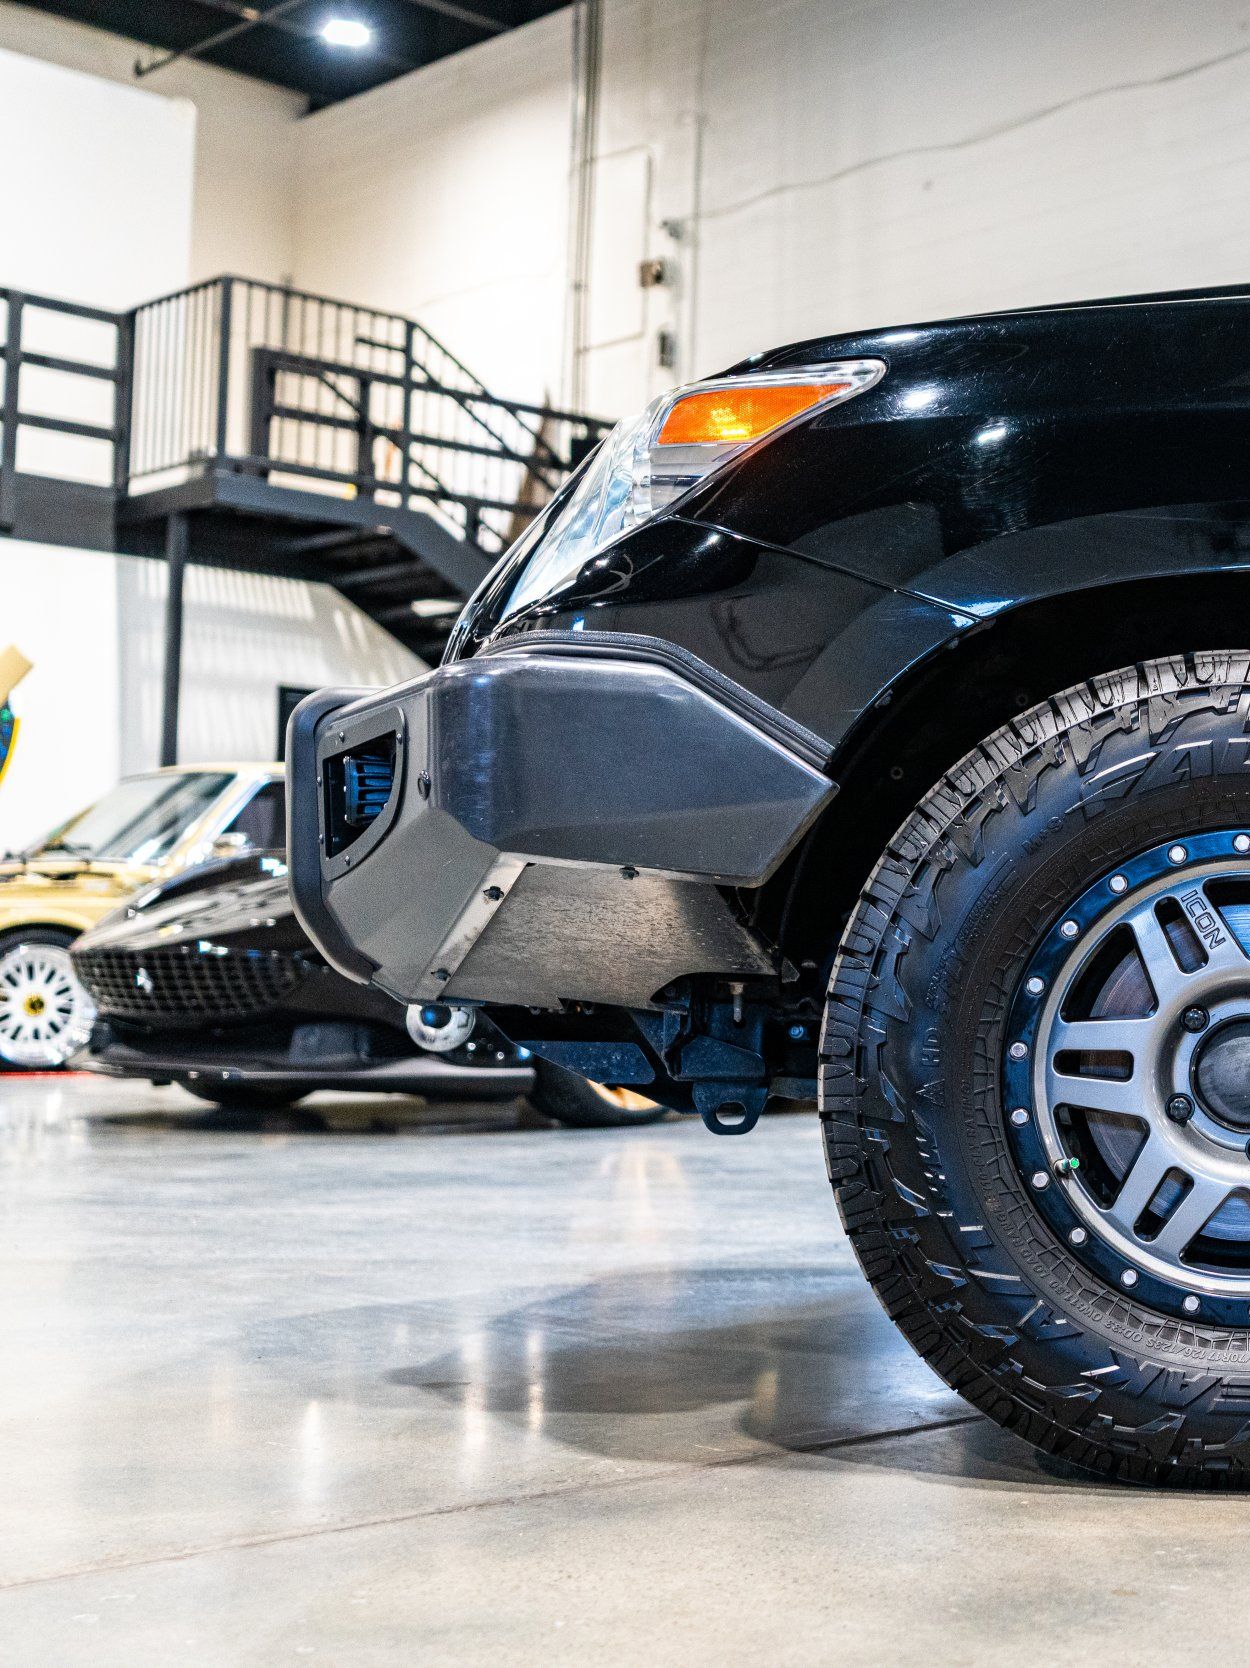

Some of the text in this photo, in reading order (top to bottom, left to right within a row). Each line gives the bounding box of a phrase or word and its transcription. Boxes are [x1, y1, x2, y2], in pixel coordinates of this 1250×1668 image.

[1181, 889, 1225, 950] ICON
[1017, 1245, 1051, 1281] LOAD
[1143, 1334, 1206, 1363] 126/123S
